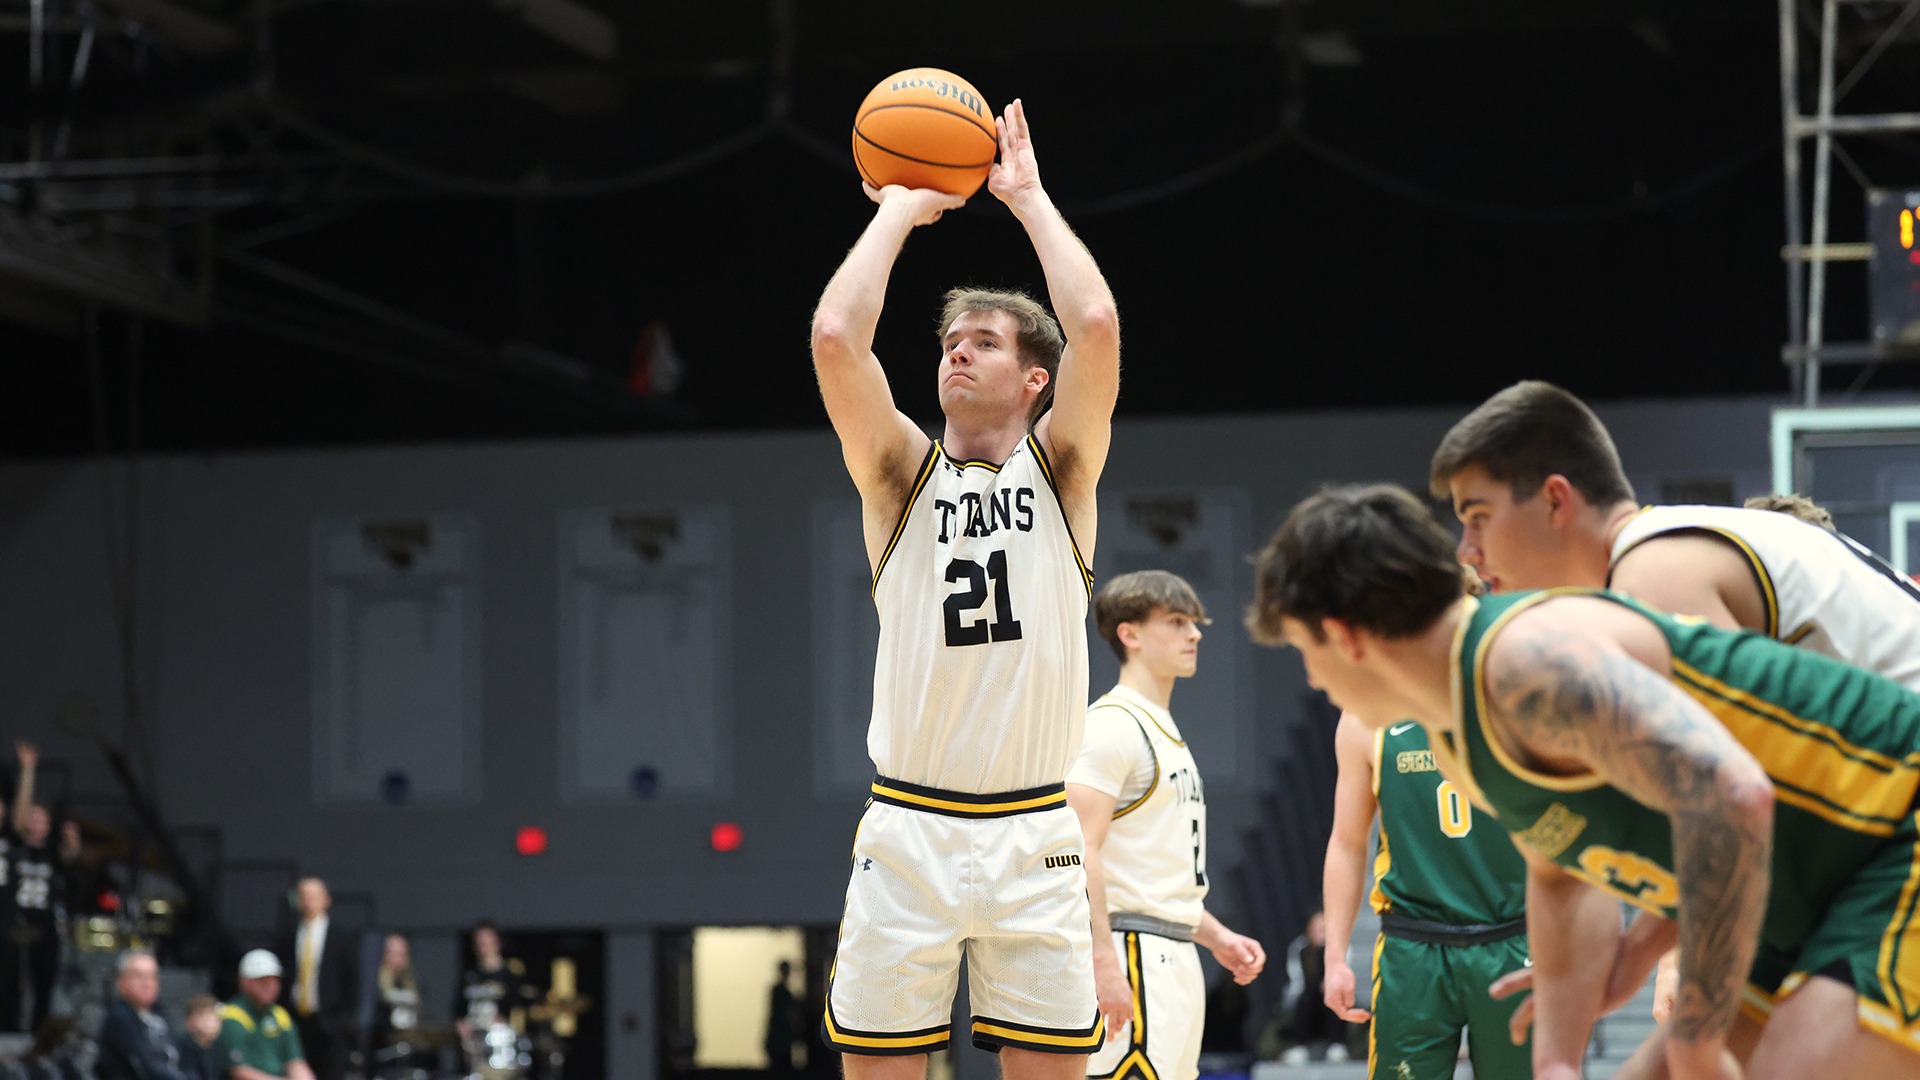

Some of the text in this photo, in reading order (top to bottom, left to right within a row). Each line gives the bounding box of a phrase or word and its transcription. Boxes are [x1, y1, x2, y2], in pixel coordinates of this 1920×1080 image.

[891, 78, 983, 118] Wilson
[934, 487, 1035, 544] TTANS
[943, 549, 1023, 647] 21
[1436, 779, 1473, 838] 0
[1044, 854, 1082, 869] UWO
